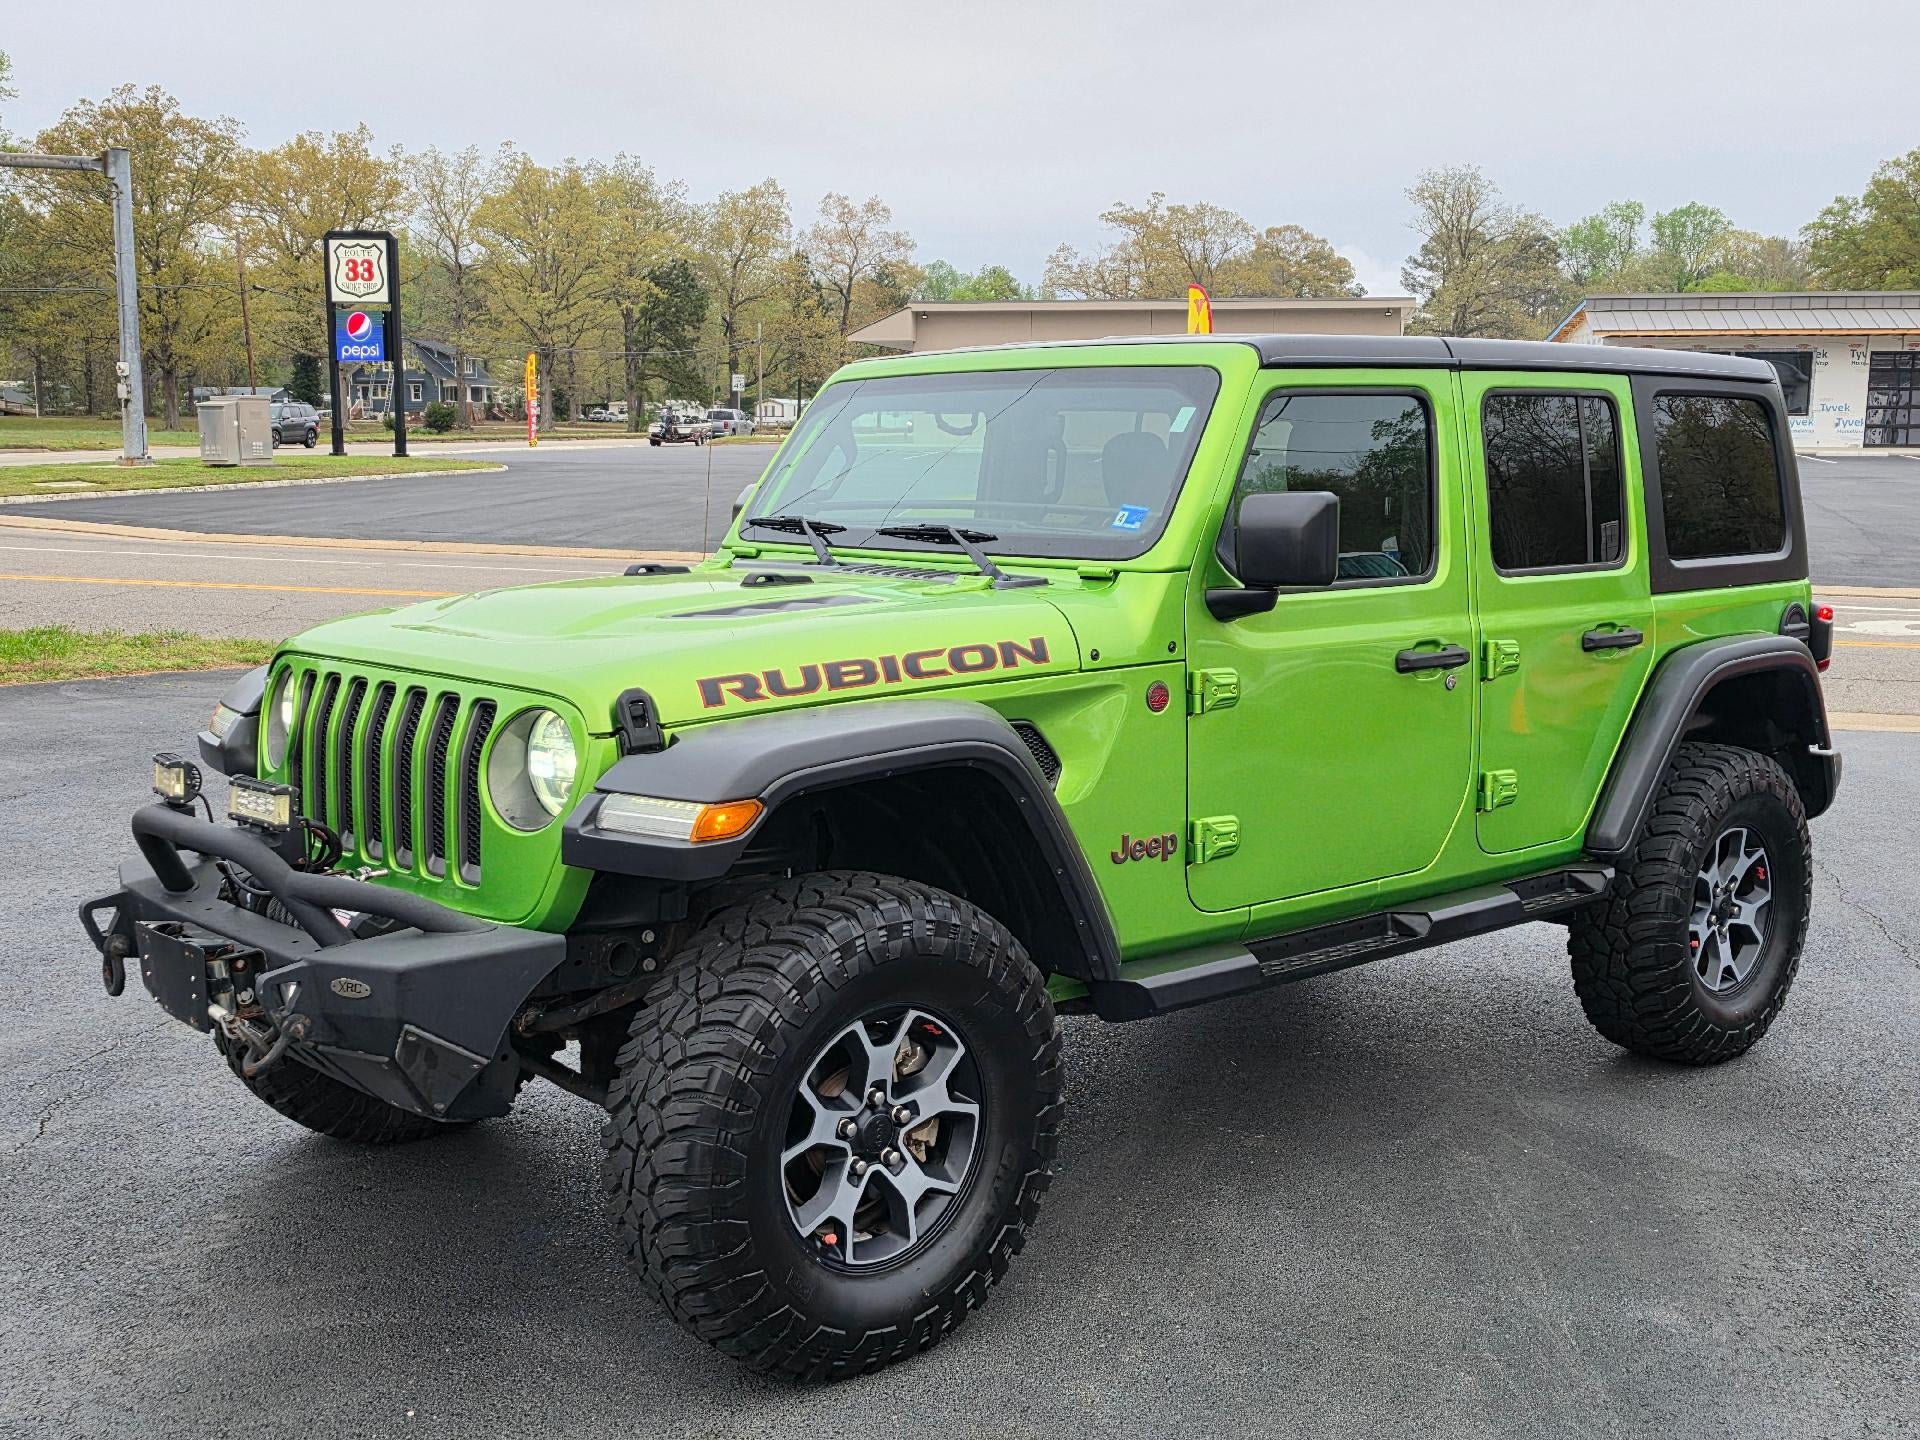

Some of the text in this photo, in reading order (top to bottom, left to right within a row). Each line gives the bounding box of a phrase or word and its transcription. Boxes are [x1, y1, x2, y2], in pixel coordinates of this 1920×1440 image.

[344, 249, 373, 257] ROUTE
[345, 258, 375, 282] 33
[342, 343, 379, 358] pepsi
[1821, 403, 1850, 412] Tyvek
[1790, 417, 1814, 427] yvek
[696, 637, 1050, 708] RUBICON
[1111, 832, 1178, 864] Jeep
[338, 980, 362, 994] XRC
